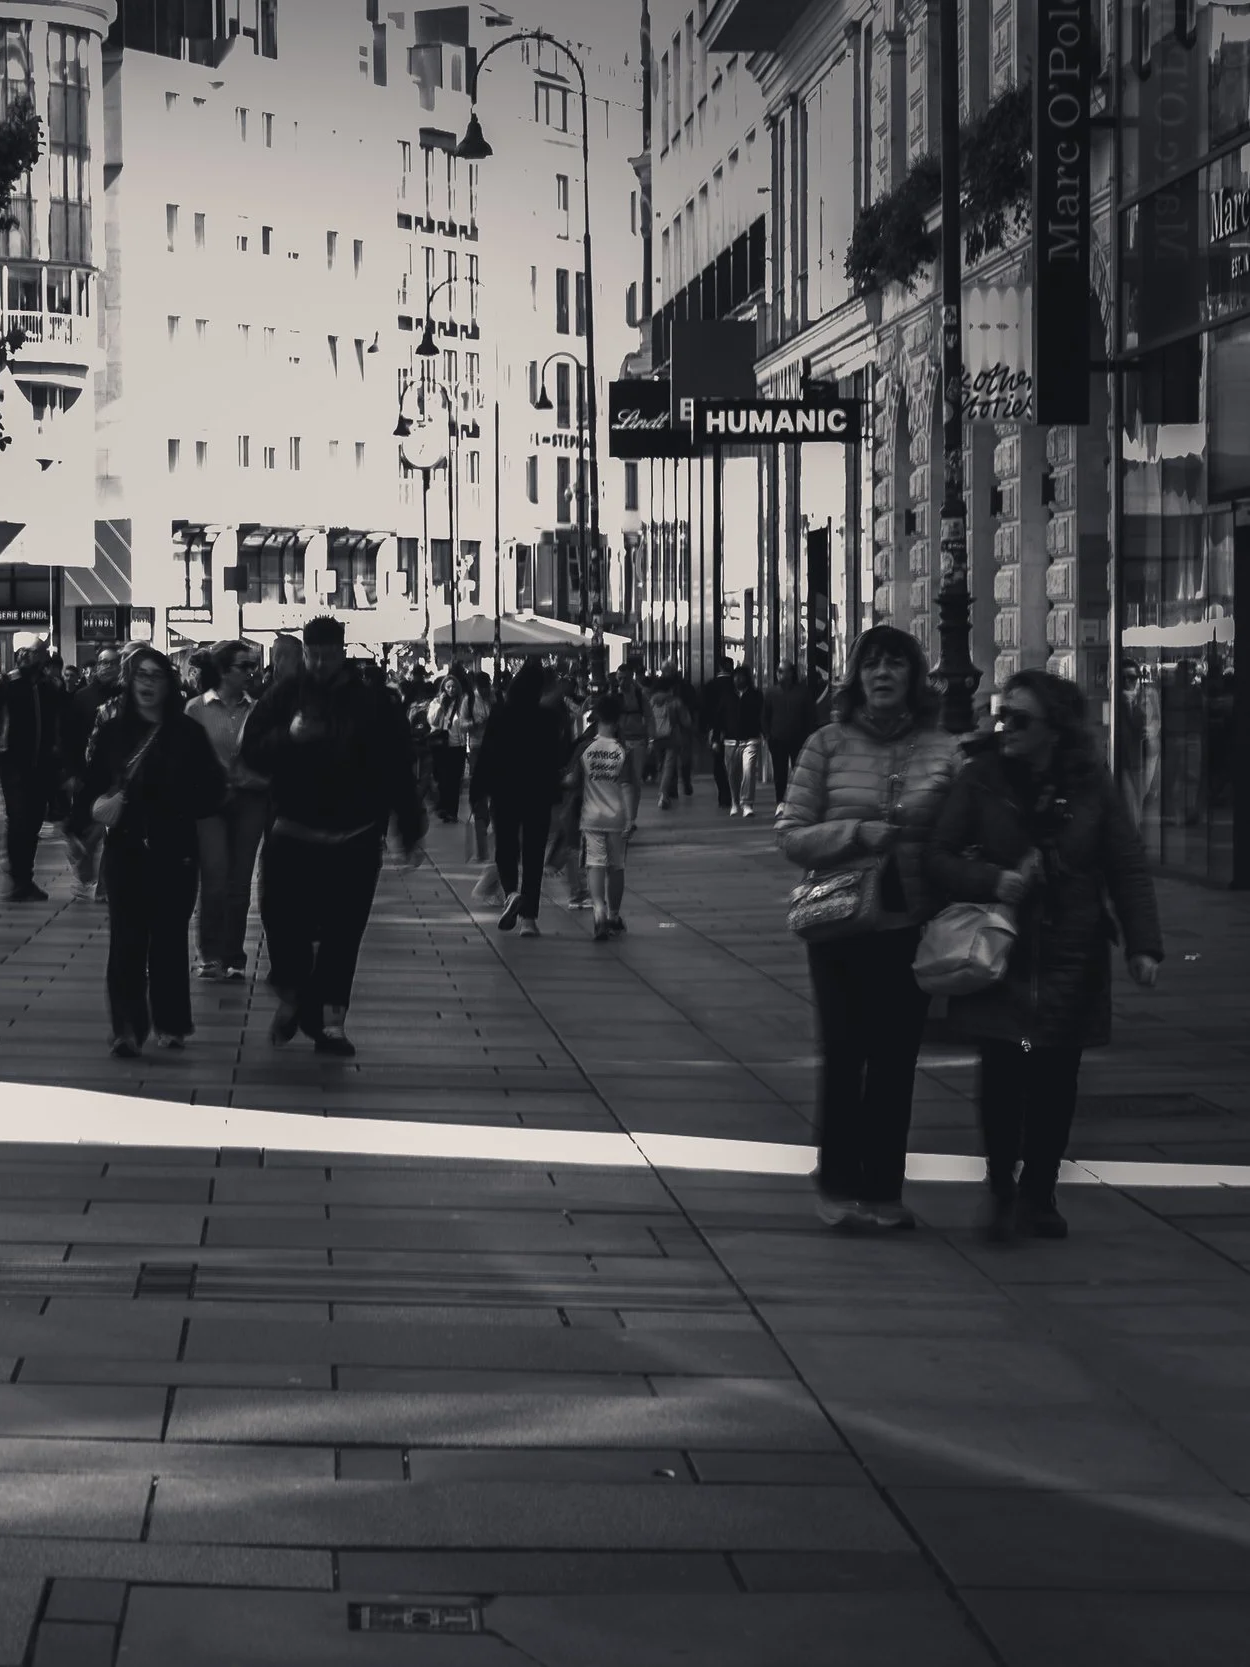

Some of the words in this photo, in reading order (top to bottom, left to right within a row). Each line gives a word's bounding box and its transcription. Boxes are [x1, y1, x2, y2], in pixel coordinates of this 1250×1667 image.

[1048, 0, 1081, 128] O'Pol
[1048, 141, 1081, 262] Marc
[1209, 187, 1250, 244] Marc
[611, 408, 669, 430] Lindt
[705, 408, 849, 434] HUMANIC
[21, 610, 49, 620] HEINDL
[83, 618, 115, 628] HEINDL
